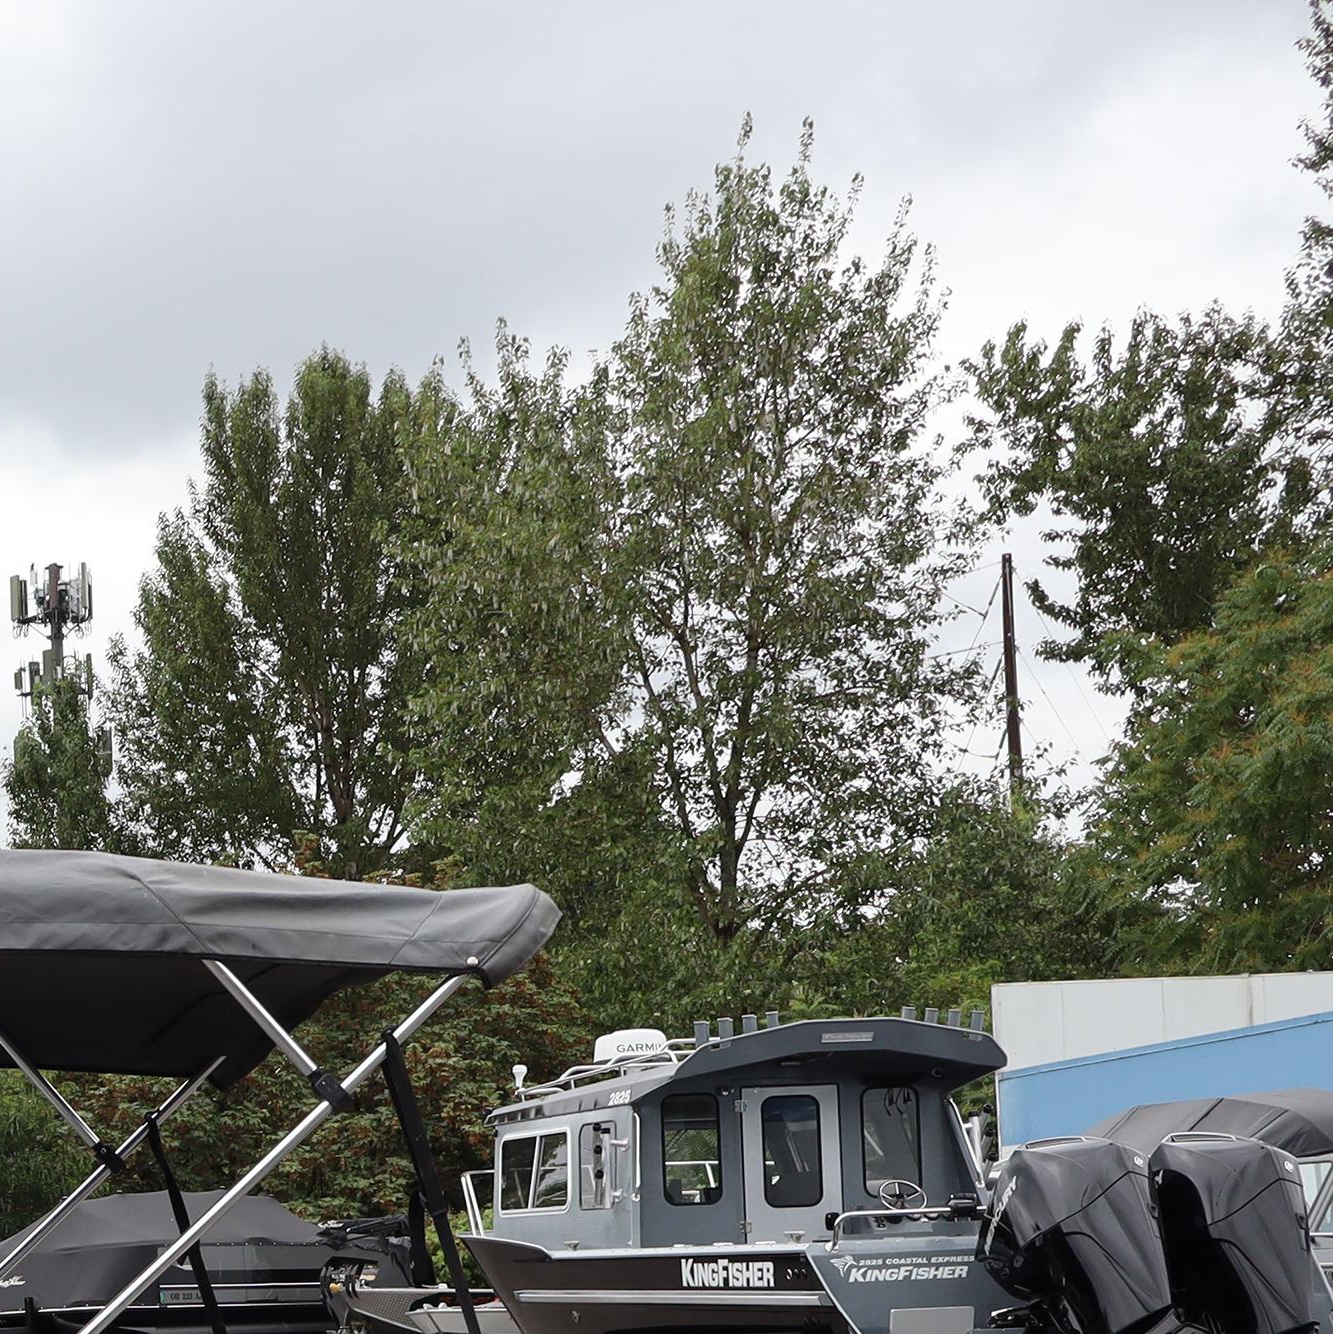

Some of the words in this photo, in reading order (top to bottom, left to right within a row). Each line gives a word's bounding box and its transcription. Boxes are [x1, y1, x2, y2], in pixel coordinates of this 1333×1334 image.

[616, 1043, 663, 1053] GARMI
[608, 1089, 632, 1106] 2825
[858, 1258, 883, 1266] 2825
[885, 1256, 928, 1265] COASTAL
[930, 1255, 975, 1263] EXPRESS
